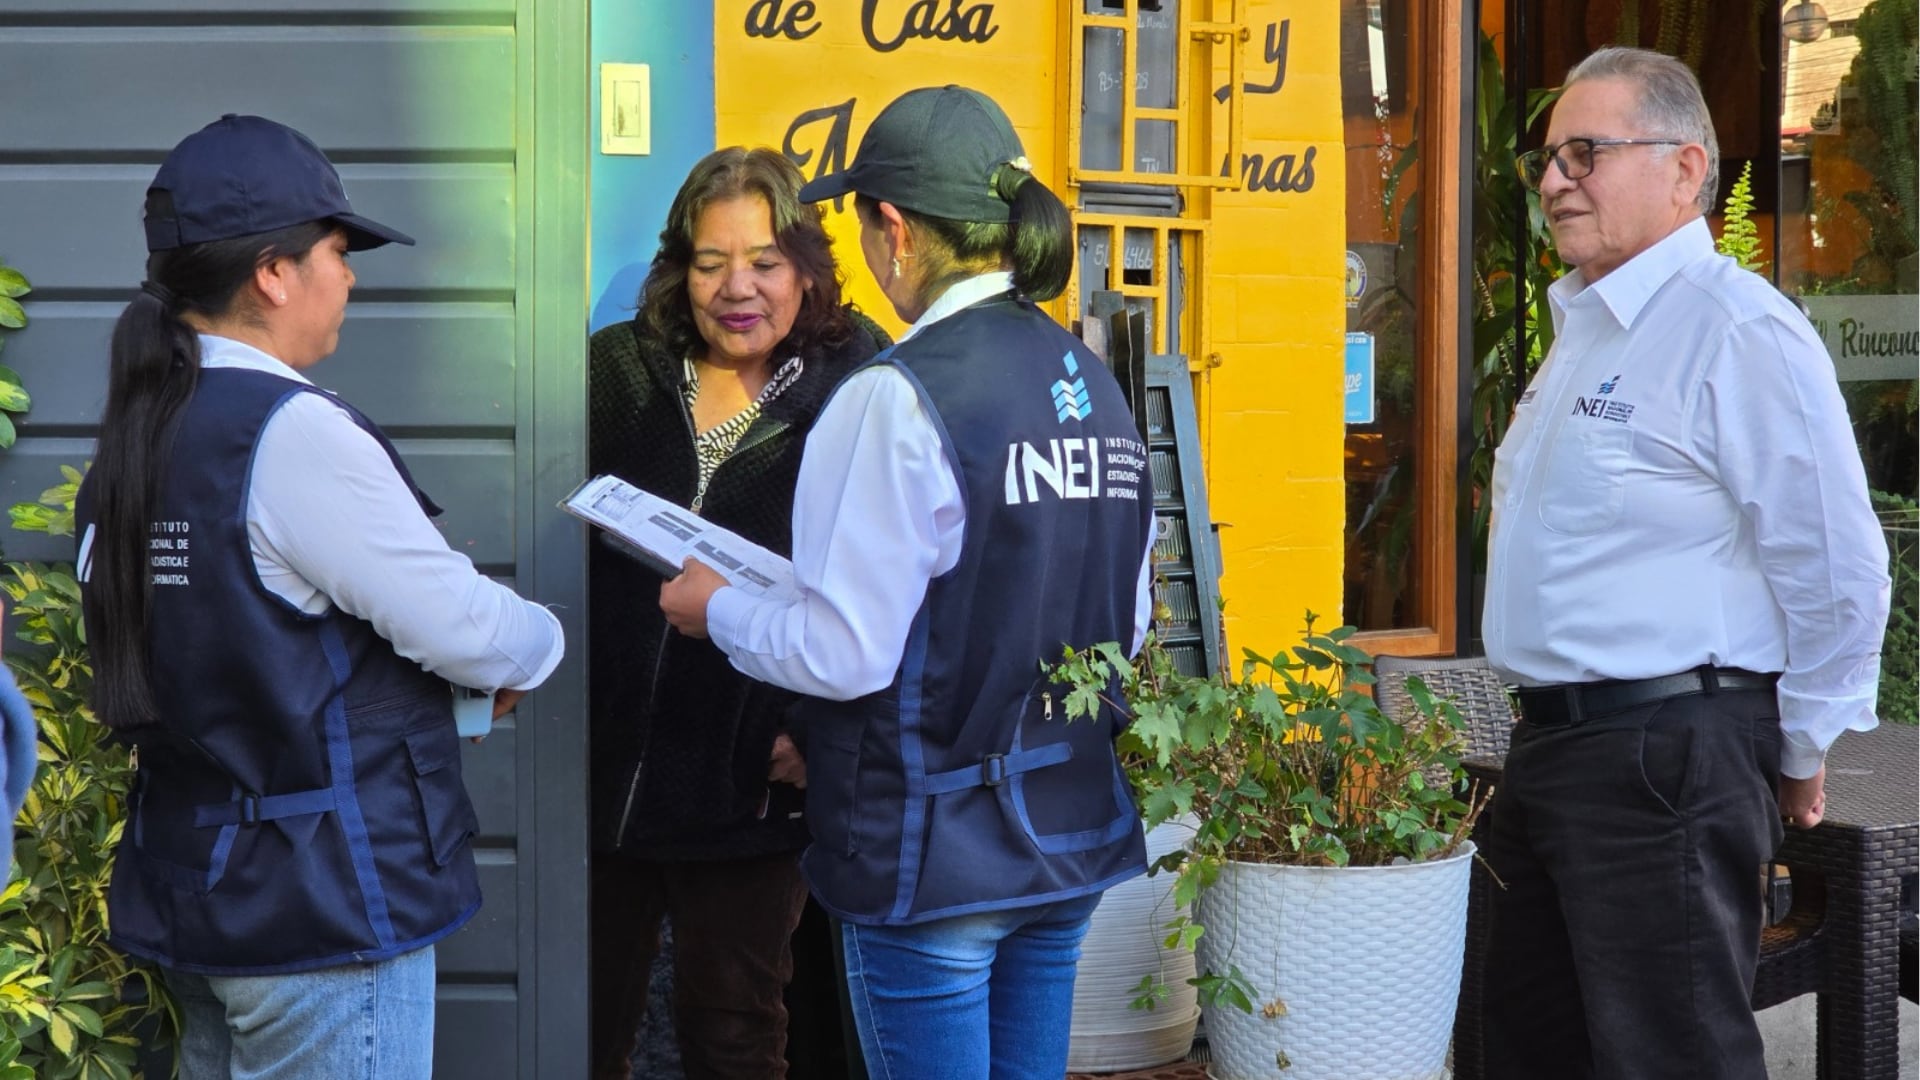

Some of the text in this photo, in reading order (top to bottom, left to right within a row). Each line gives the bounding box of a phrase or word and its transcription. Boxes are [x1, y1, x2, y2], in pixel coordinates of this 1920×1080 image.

[745, 0, 999, 53] de Casa
[1213, 19, 1290, 104] y
[1572, 396, 1607, 418] INEI
[1005, 437, 1099, 505] INEI
[177, 538, 189, 550] DE
